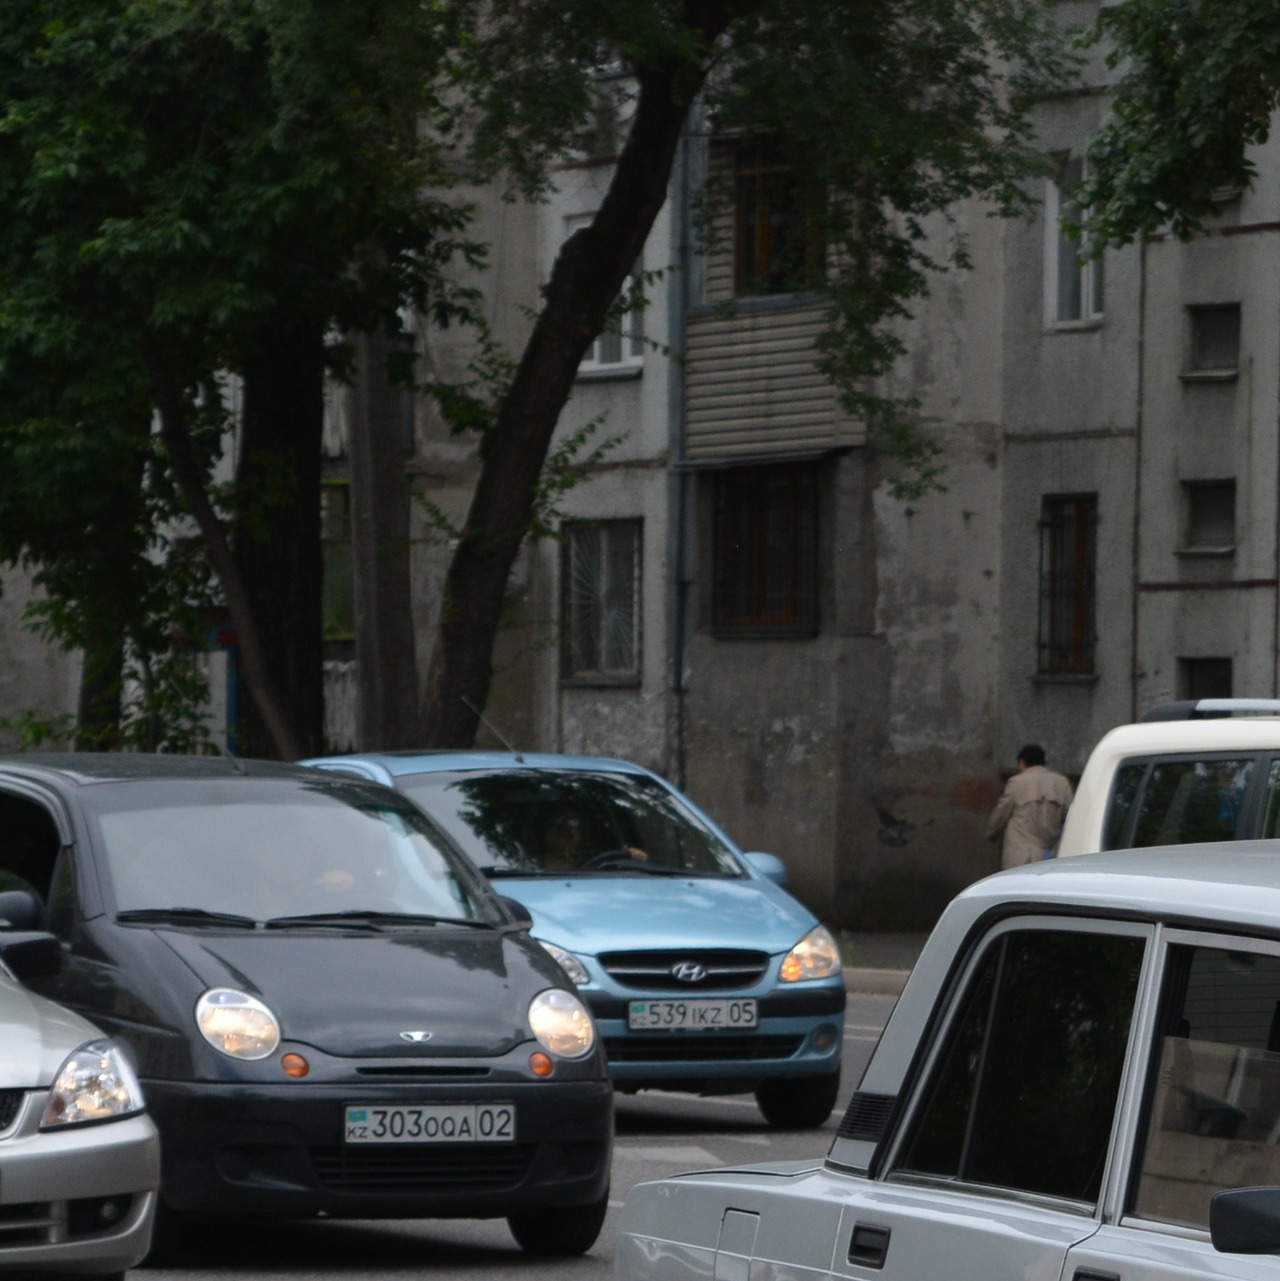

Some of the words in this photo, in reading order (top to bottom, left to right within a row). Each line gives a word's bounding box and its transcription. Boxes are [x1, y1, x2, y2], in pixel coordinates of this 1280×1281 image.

[729, 1002, 754, 1023] 05
[347, 1126, 368, 1139] KZ
[479, 1109, 512, 1137] 02
